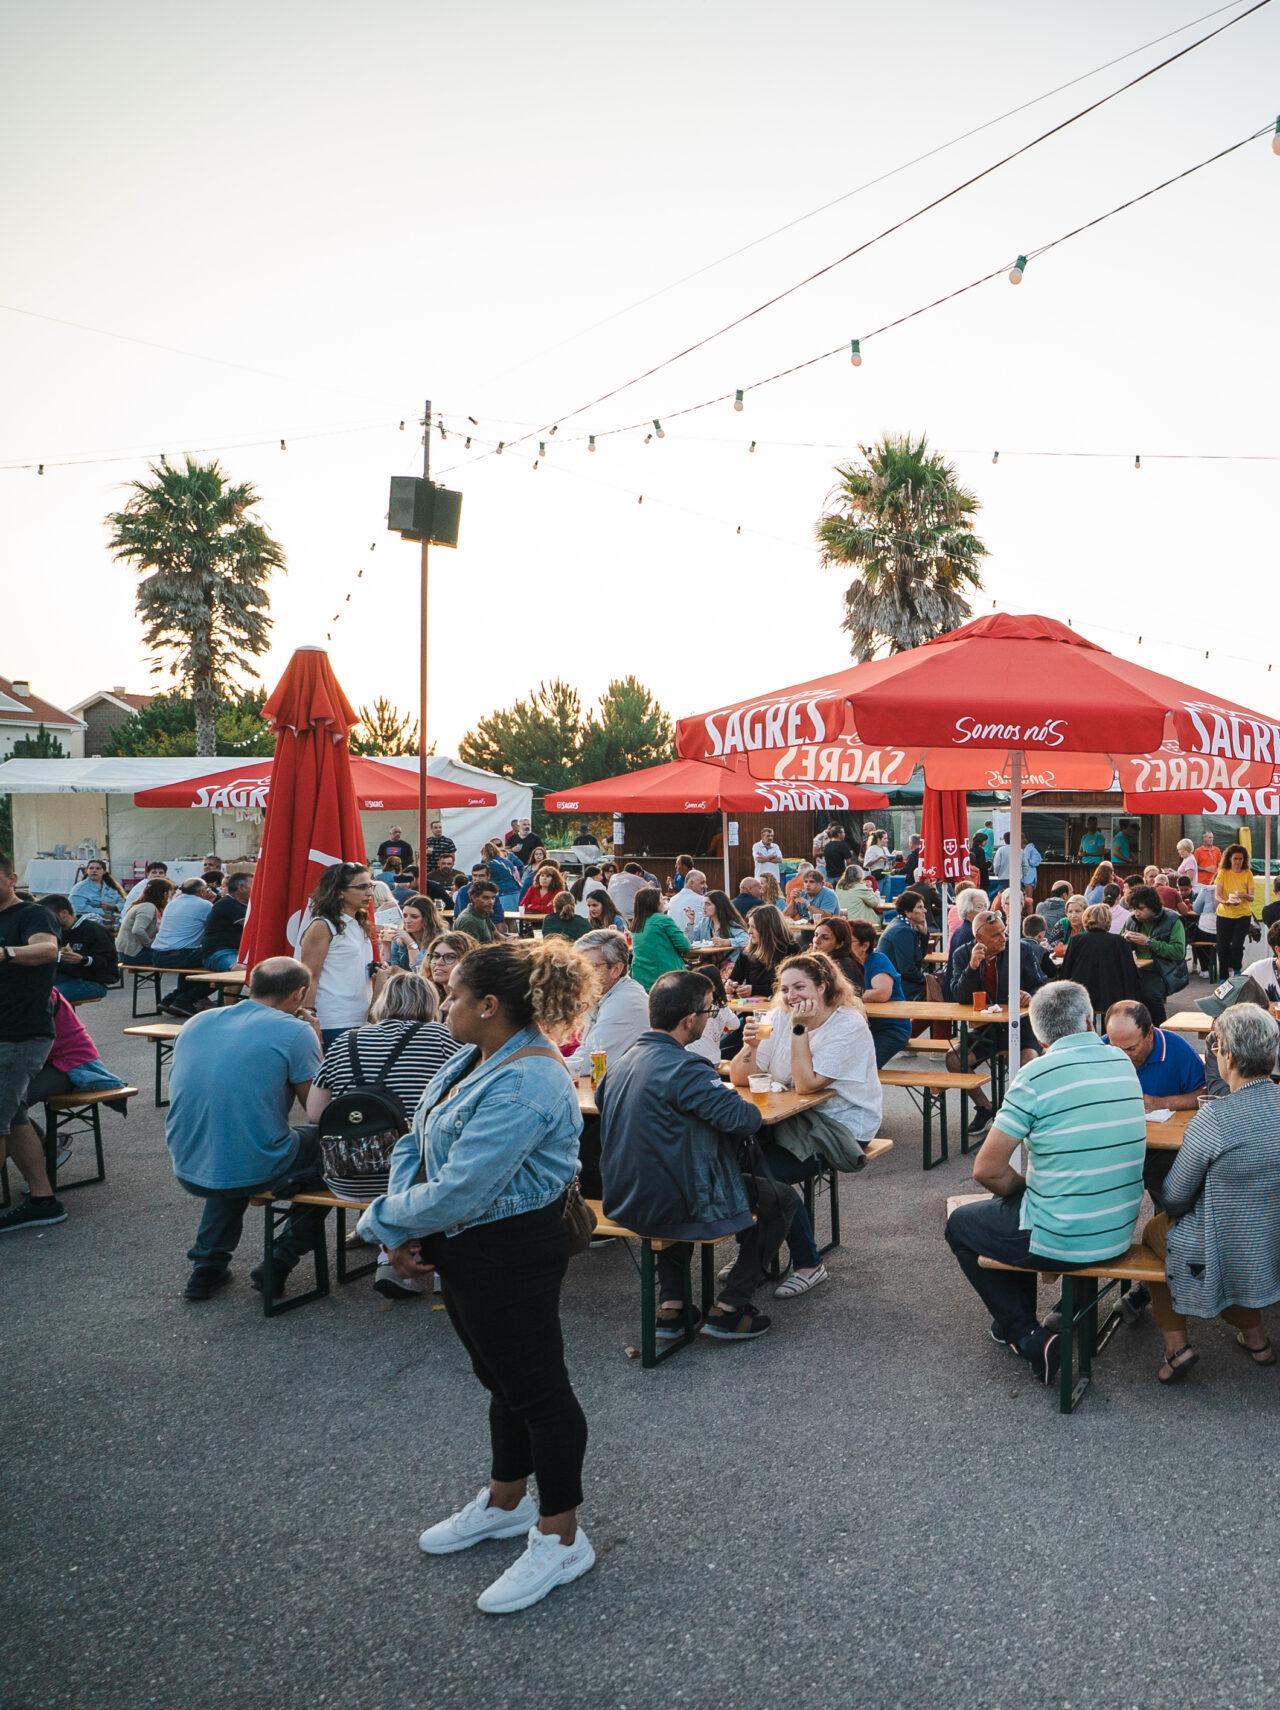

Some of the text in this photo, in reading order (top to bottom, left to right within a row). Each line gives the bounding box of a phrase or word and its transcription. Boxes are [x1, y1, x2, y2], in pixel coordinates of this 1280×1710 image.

[705, 699, 826, 758] SAGRES
[952, 716, 1020, 744] Somos
[191, 785, 270, 808] SAGR
[755, 788, 849, 813] SAGRES
